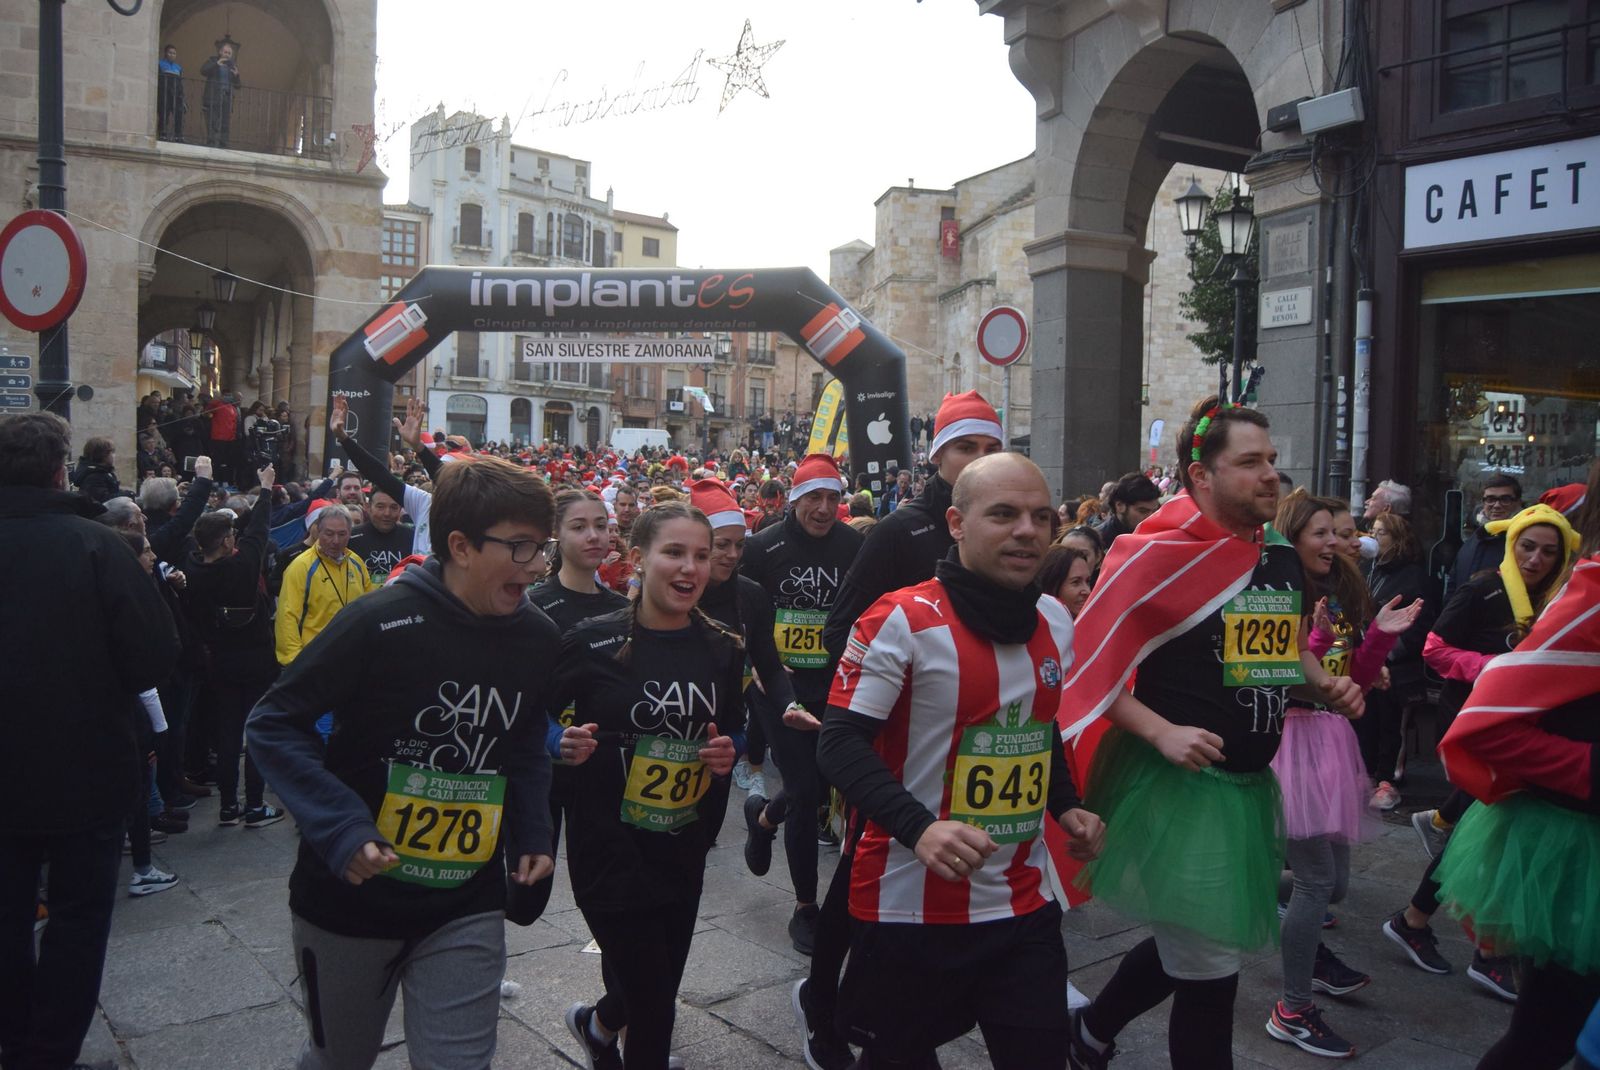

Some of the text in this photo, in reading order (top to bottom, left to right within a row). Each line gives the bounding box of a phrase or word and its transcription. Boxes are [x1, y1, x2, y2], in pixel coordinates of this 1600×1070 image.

[1426, 161, 1586, 223] CAFET
[471, 272, 755, 317] implantes
[1277, 293, 1299, 302] CALLE
[525, 342, 713, 359] SAN SILVESTRE ZAMORANA
[780, 566, 839, 595] SAN
[1248, 604, 1293, 612] CAJA RURAL
[380, 616, 413, 631] luanvi
[782, 627, 823, 650] 1251
[1234, 618, 1291, 656] 1239
[1251, 668, 1300, 678] CAJA RURAL
[415, 680, 522, 737] SAN
[630, 680, 717, 730] SAN
[995, 744, 1019, 755] CAJA
[429, 777, 491, 791] FUNDACION
[640, 763, 708, 802] 281
[966, 762, 1044, 810] 643
[427, 788, 488, 801] CAJA RURAL
[395, 802, 483, 855] 1278
[985, 823, 1014, 835] CAJA
[402, 864, 434, 880] CAJA
